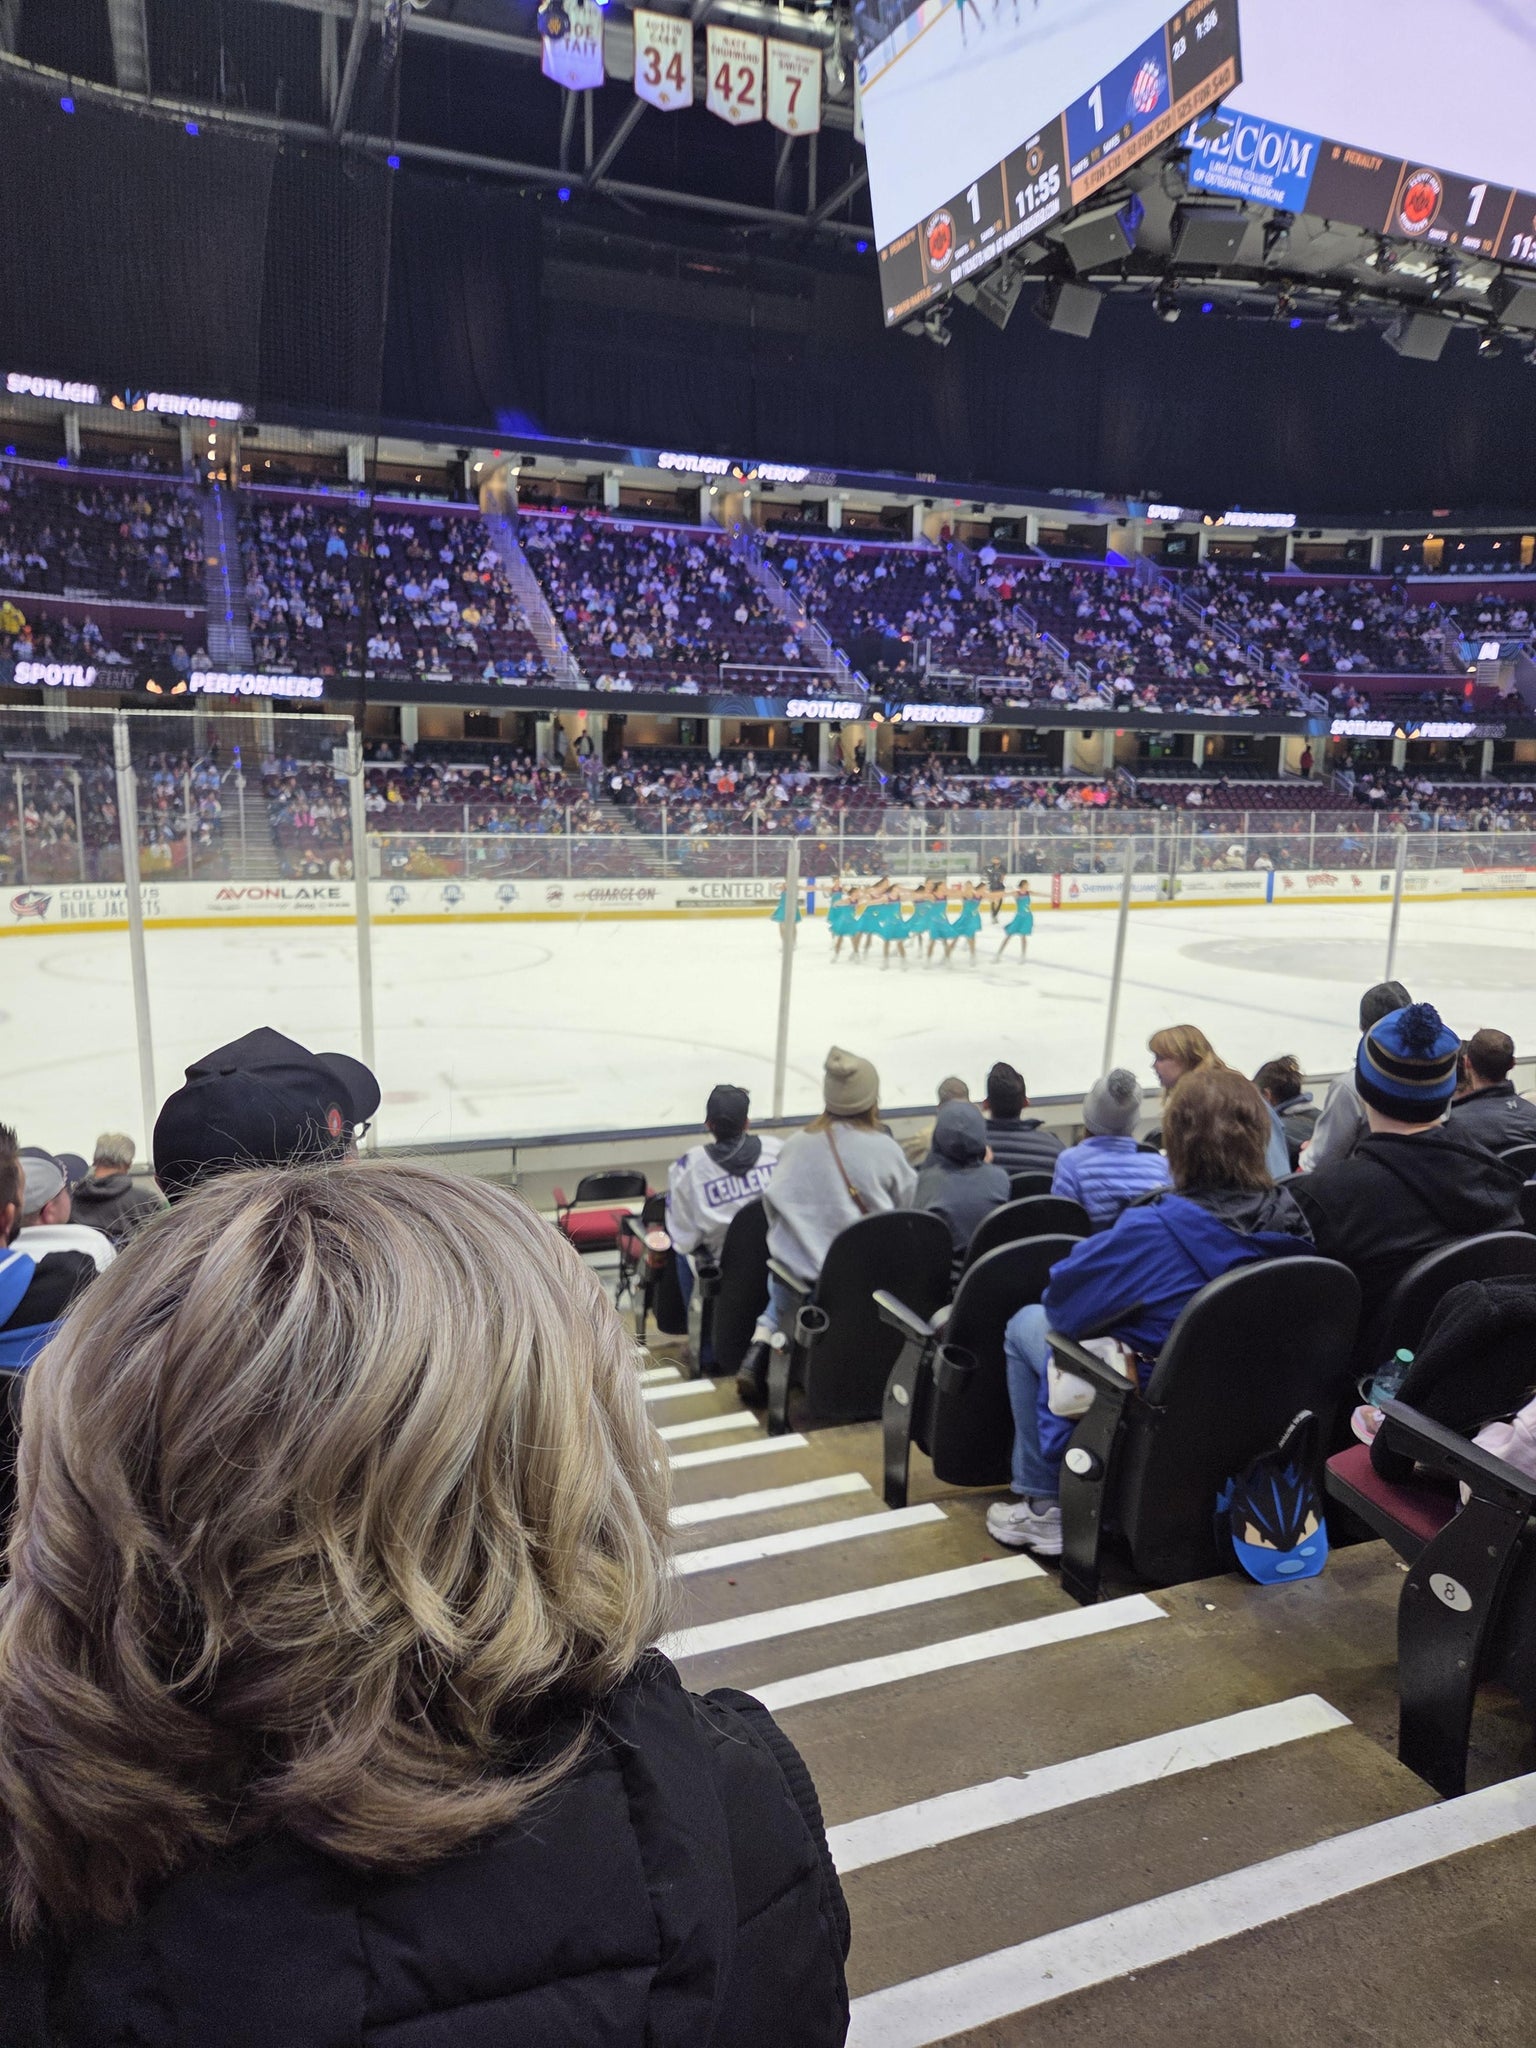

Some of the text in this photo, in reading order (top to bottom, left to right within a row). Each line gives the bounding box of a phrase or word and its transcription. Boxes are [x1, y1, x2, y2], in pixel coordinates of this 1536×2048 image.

[564, 37, 597, 57] TAIT
[643, 47, 685, 92] 34
[714, 61, 756, 106] 42
[785, 76, 802, 114] 7
[1088, 84, 1104, 133] 1
[967, 182, 981, 225] 1
[1015, 163, 1061, 219] 11:55
[1466, 182, 1488, 227] 1
[658, 452, 731, 475] SPOTLIGHT
[189, 671, 324, 698] PERFORMERS
[59, 888, 160, 900] COLUMUS
[701, 882, 762, 899] CENTER
[60, 901, 97, 919] BLUE
[706, 1165, 773, 1205] CEULEM
[1444, 1582, 1456, 1601] 8
